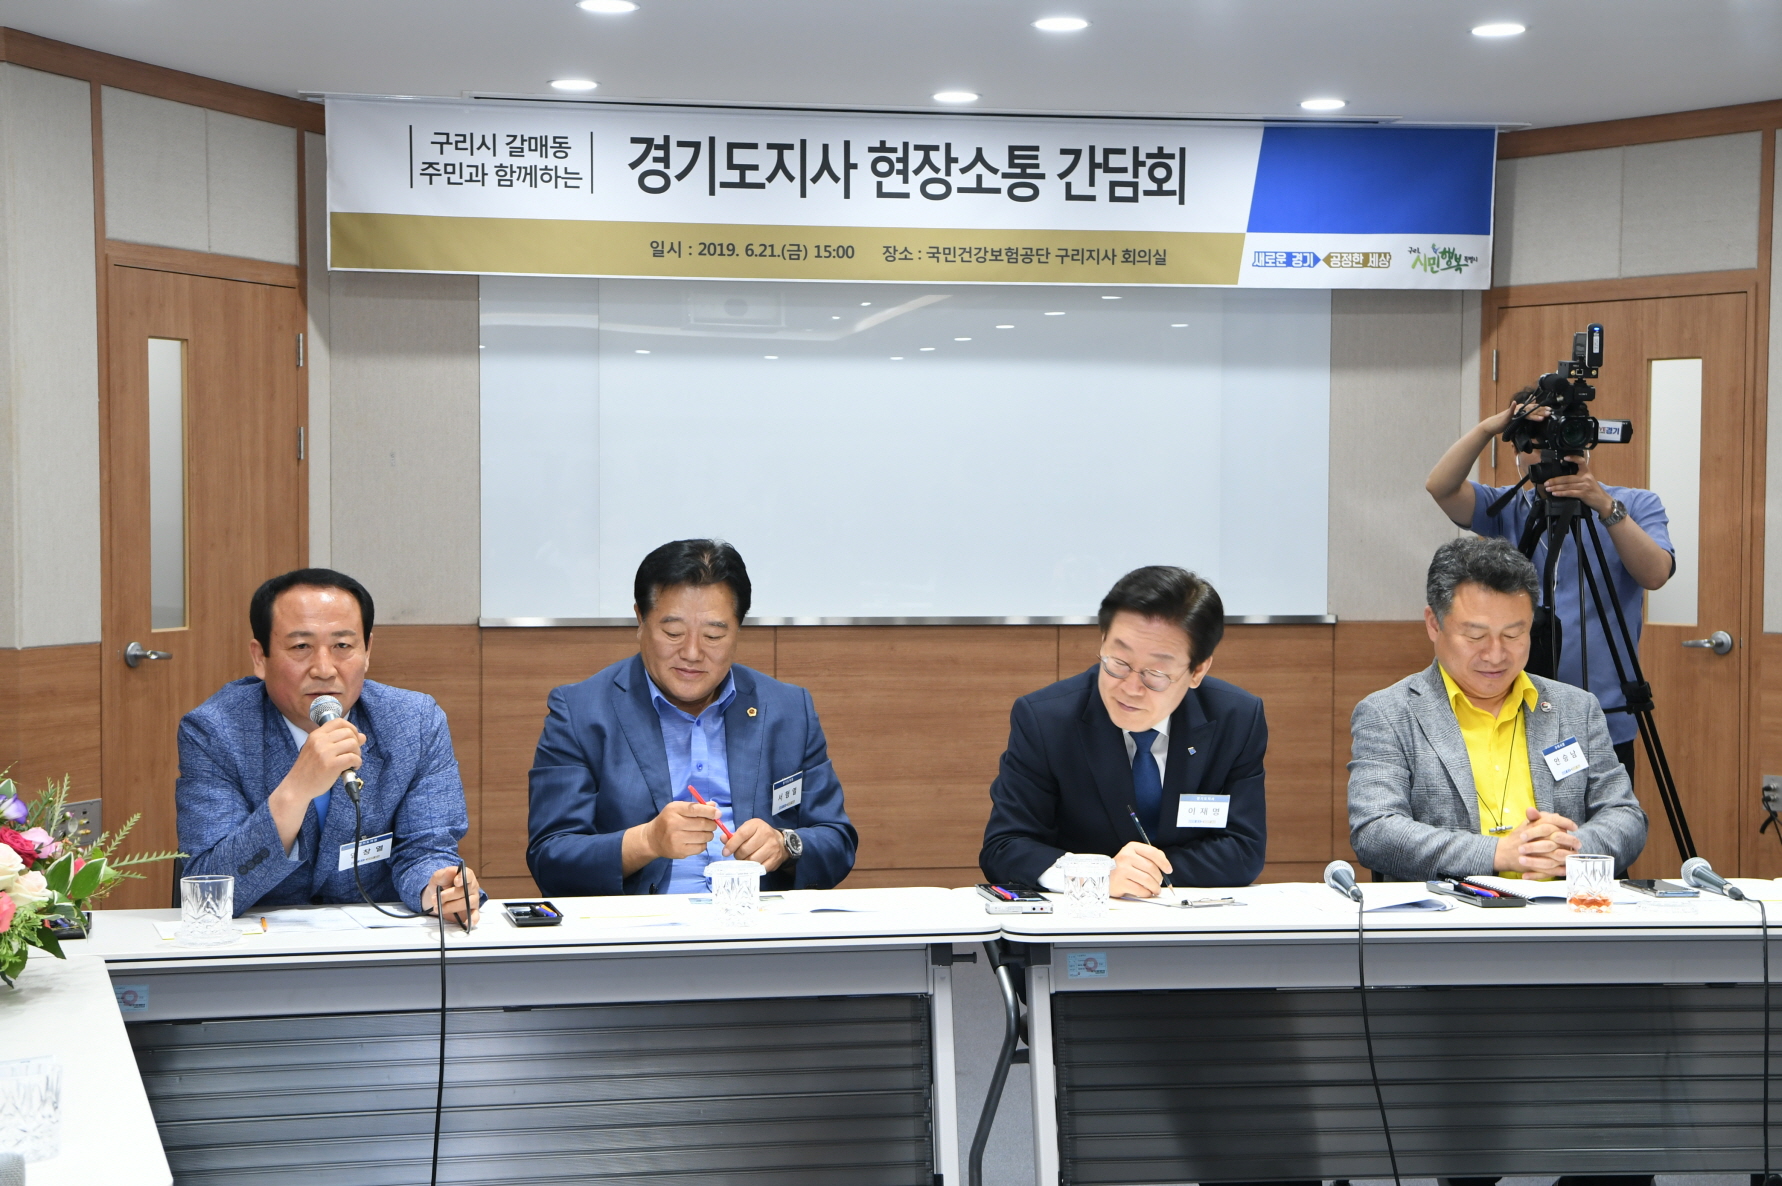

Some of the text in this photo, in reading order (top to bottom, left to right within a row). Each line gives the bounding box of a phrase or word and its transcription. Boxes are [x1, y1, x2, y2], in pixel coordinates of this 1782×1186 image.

[430, 131, 572, 160] 구리시 갈매동
[419, 161, 584, 190] 주민과 함께하는
[627, 134, 1187, 206] 경기도지사 현장소통 간담회
[649, 240, 682, 259] 일시
[697, 241, 740, 257] 2019.
[744, 242, 808, 261] 6.21.(금)
[814, 244, 855, 260] 15:00
[882, 245, 914, 263] 장소
[925, 246, 1052, 265] 국민건강보험공단
[1054, 247, 1118, 266] 구리지사
[1120, 247, 1167, 266] 회의실
[1253, 252, 1315, 268] 새로운 경기
[1330, 252, 1392, 268] 공정한 세상
